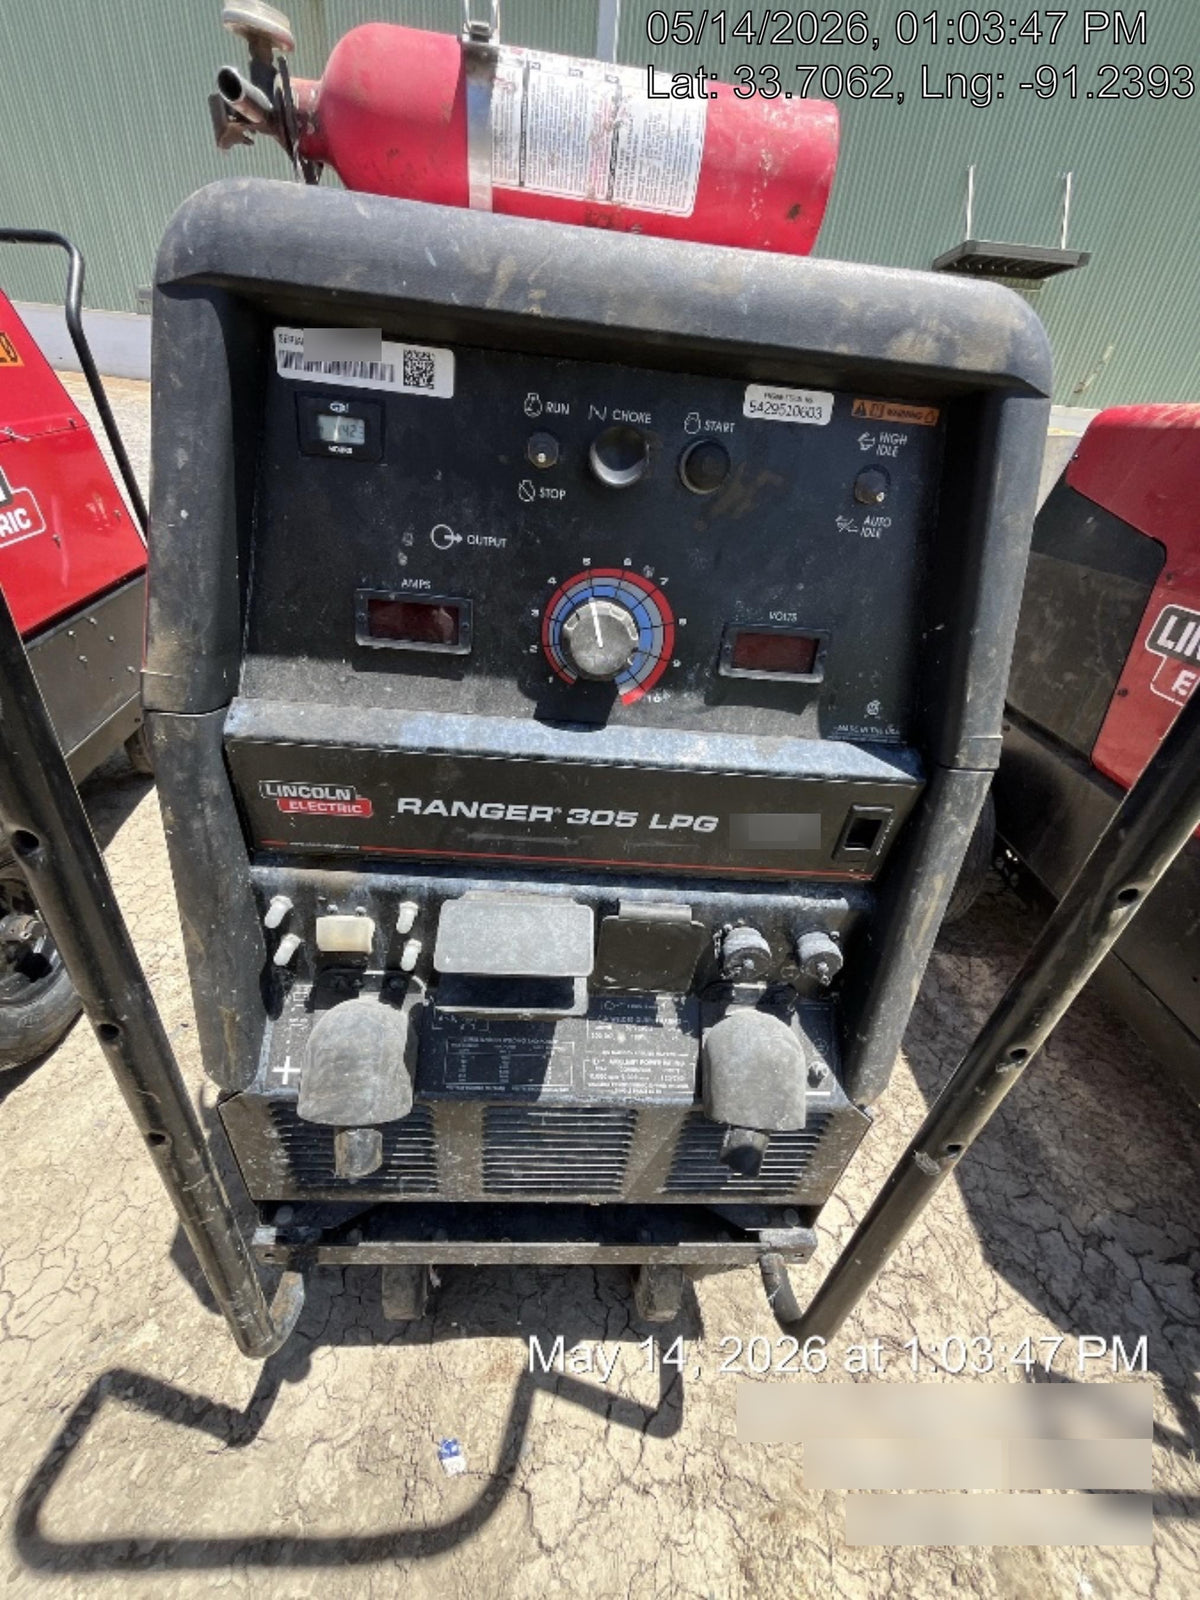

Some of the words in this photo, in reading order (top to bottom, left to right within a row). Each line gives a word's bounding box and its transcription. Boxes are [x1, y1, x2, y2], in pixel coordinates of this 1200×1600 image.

[545, 401, 570, 416] RUN
[612, 409, 651, 424] CHOKE
[704, 420, 735, 433] START
[879, 432, 907, 446] HIGH
[876, 446, 900, 458] IDLE
[539, 488, 567, 500] STOP
[863, 515, 892, 528] AUTO
[860, 526, 882, 538] IDLE
[467, 534, 507, 549] OUTPUT
[401, 578, 432, 590] AMPS
[547, 576, 557, 585] 4
[660, 577, 669, 587] 7
[769, 611, 798, 623] VOLTS
[265, 783, 351, 801] LINCOLN
[288, 801, 364, 814] ELECTRIC
[567, 808, 639, 828] 305
[649, 813, 719, 833] LPG
